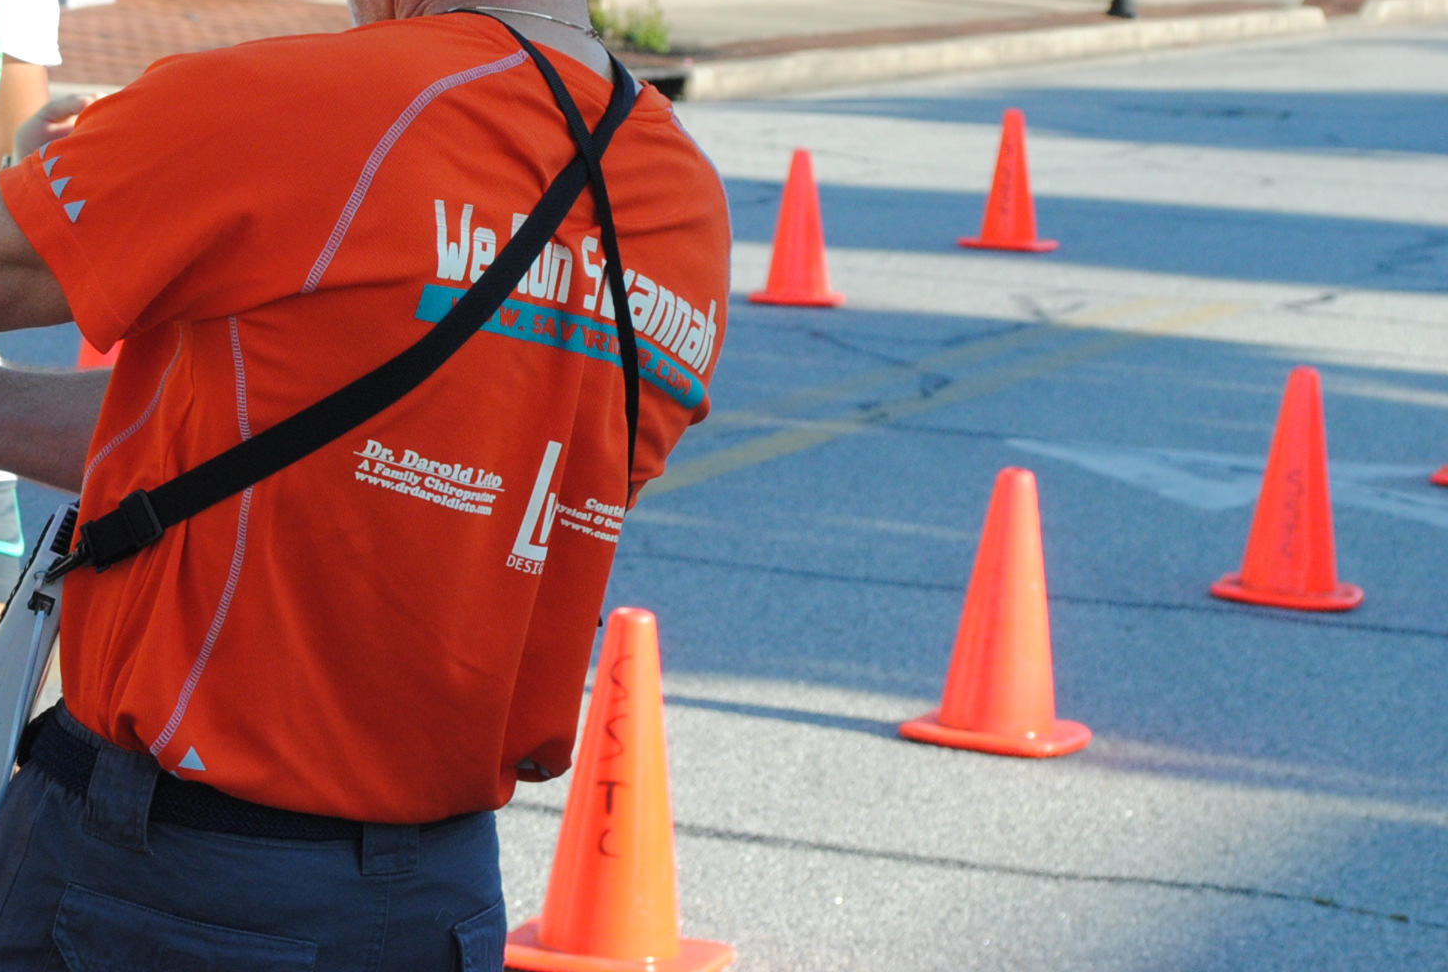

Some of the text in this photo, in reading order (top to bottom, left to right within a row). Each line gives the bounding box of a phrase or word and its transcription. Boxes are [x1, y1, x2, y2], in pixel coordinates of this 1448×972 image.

[434, 199, 497, 284] We
[357, 459, 370, 471] A
[373, 462, 422, 485] Family
[363, 439, 395, 462] Dr.
[400, 449, 474, 485] Darold
